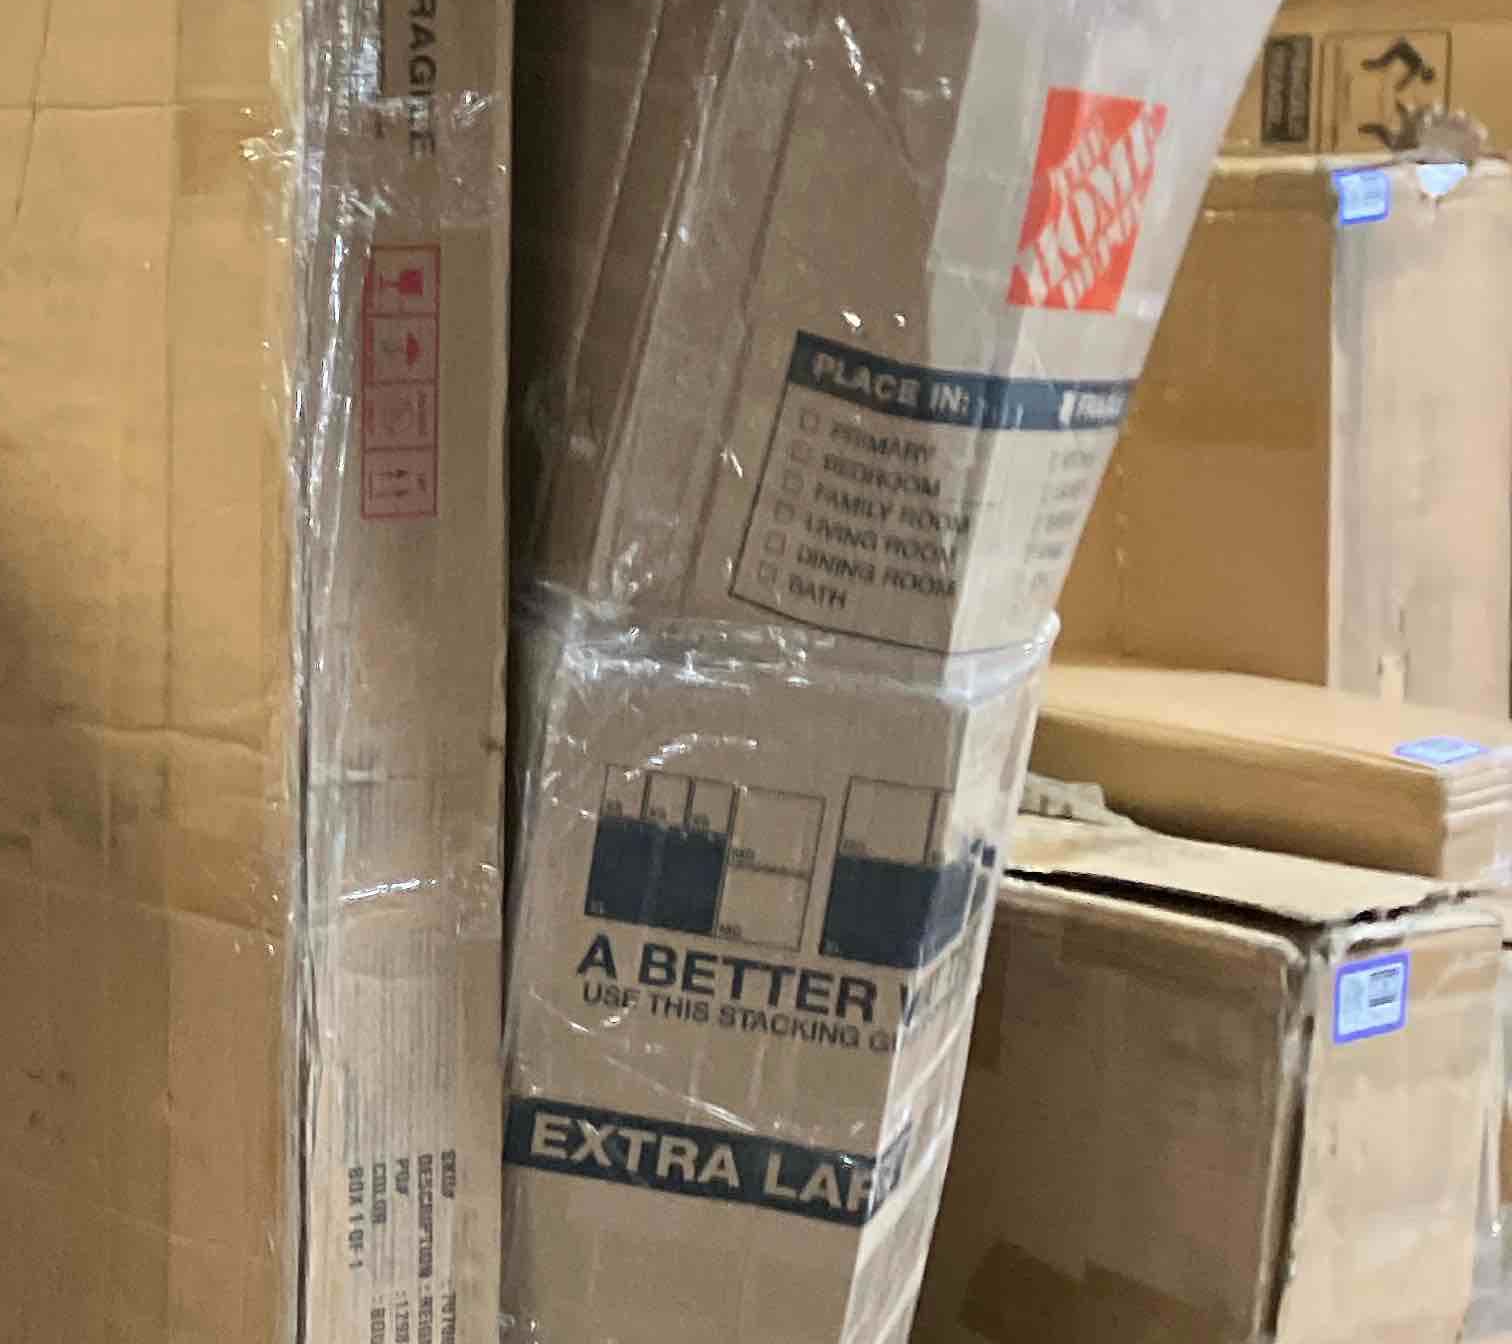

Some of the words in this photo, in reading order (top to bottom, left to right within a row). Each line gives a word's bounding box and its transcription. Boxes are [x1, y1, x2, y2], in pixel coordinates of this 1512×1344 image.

[811, 351, 920, 407] PLACE
[789, 574, 847, 609] BATH
[576, 934, 617, 980] A
[638, 942, 878, 1023] BETTER
[583, 984, 642, 1011] USE
[648, 992, 710, 1023] THIS
[719, 1006, 860, 1052] STACKING
[530, 1112, 741, 1190] EXTRA
[348, 1166, 365, 1207] BOX
[372, 1162, 388, 1225] COLOR
[348, 1229, 365, 1254] OF
